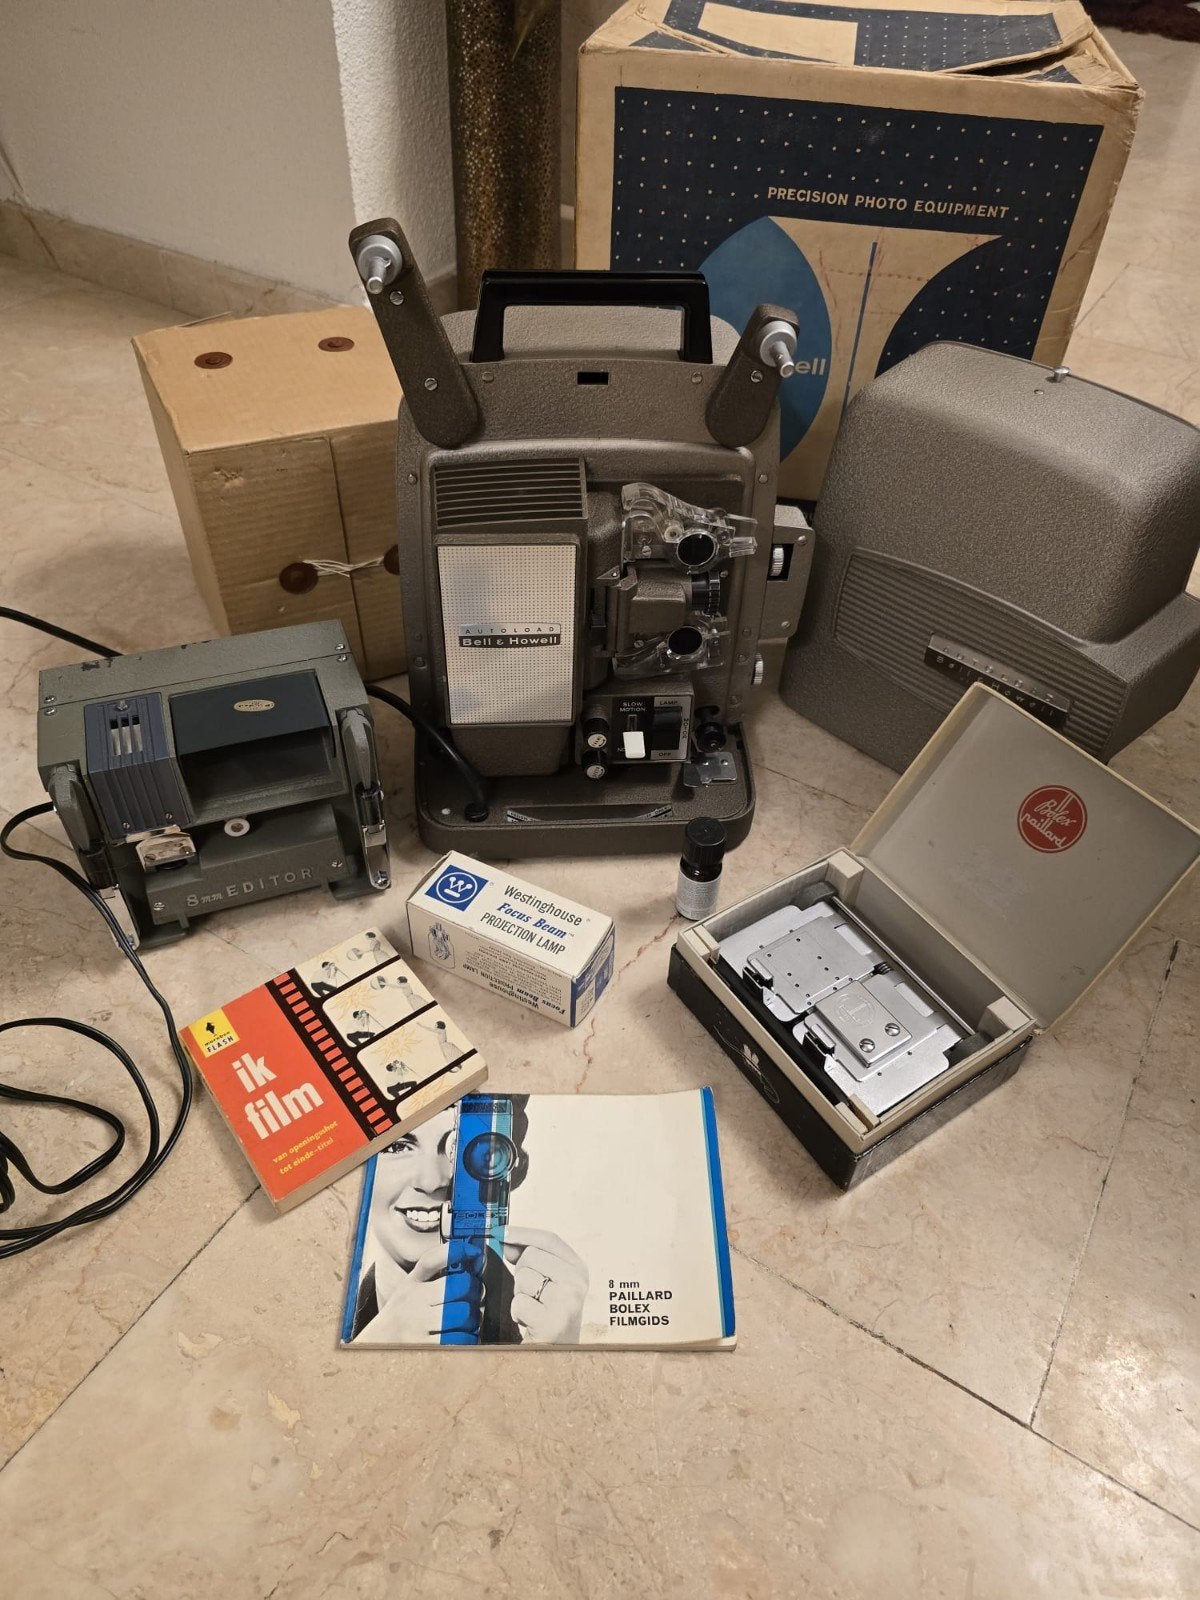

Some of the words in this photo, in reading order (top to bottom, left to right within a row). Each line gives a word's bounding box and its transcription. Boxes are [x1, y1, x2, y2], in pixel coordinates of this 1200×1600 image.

[767, 186, 849, 206] PRECISION
[854, 195, 908, 211] PHOTO
[914, 200, 1010, 219] EQUIPMENT
[794, 357, 827, 376] ell
[465, 626, 555, 635] AUTOLOAD
[462, 637, 492, 646] Bell
[509, 636, 558, 646] Howell
[225, 867, 313, 897] EDITOR
[503, 884, 583, 927] Westinghouse
[496, 902, 533, 924] Focus
[532, 917, 568, 939] Beam
[480, 912, 538, 944] PROJECTION
[536, 936, 567, 955] LAMP
[541, 999, 567, 1016] Focus
[207, 1035, 234, 1053] FLASH
[232, 1053, 277, 1093] ik
[244, 1081, 324, 1141] film
[272, 1151, 288, 1163] van
[280, 1163, 293, 1175] tot
[608, 1279, 615, 1289] 8
[619, 1281, 640, 1289] mm
[609, 1290, 673, 1301] PAILLARD
[609, 1303, 651, 1314] BOLEX
[609, 1315, 670, 1327] FILMGIDS
